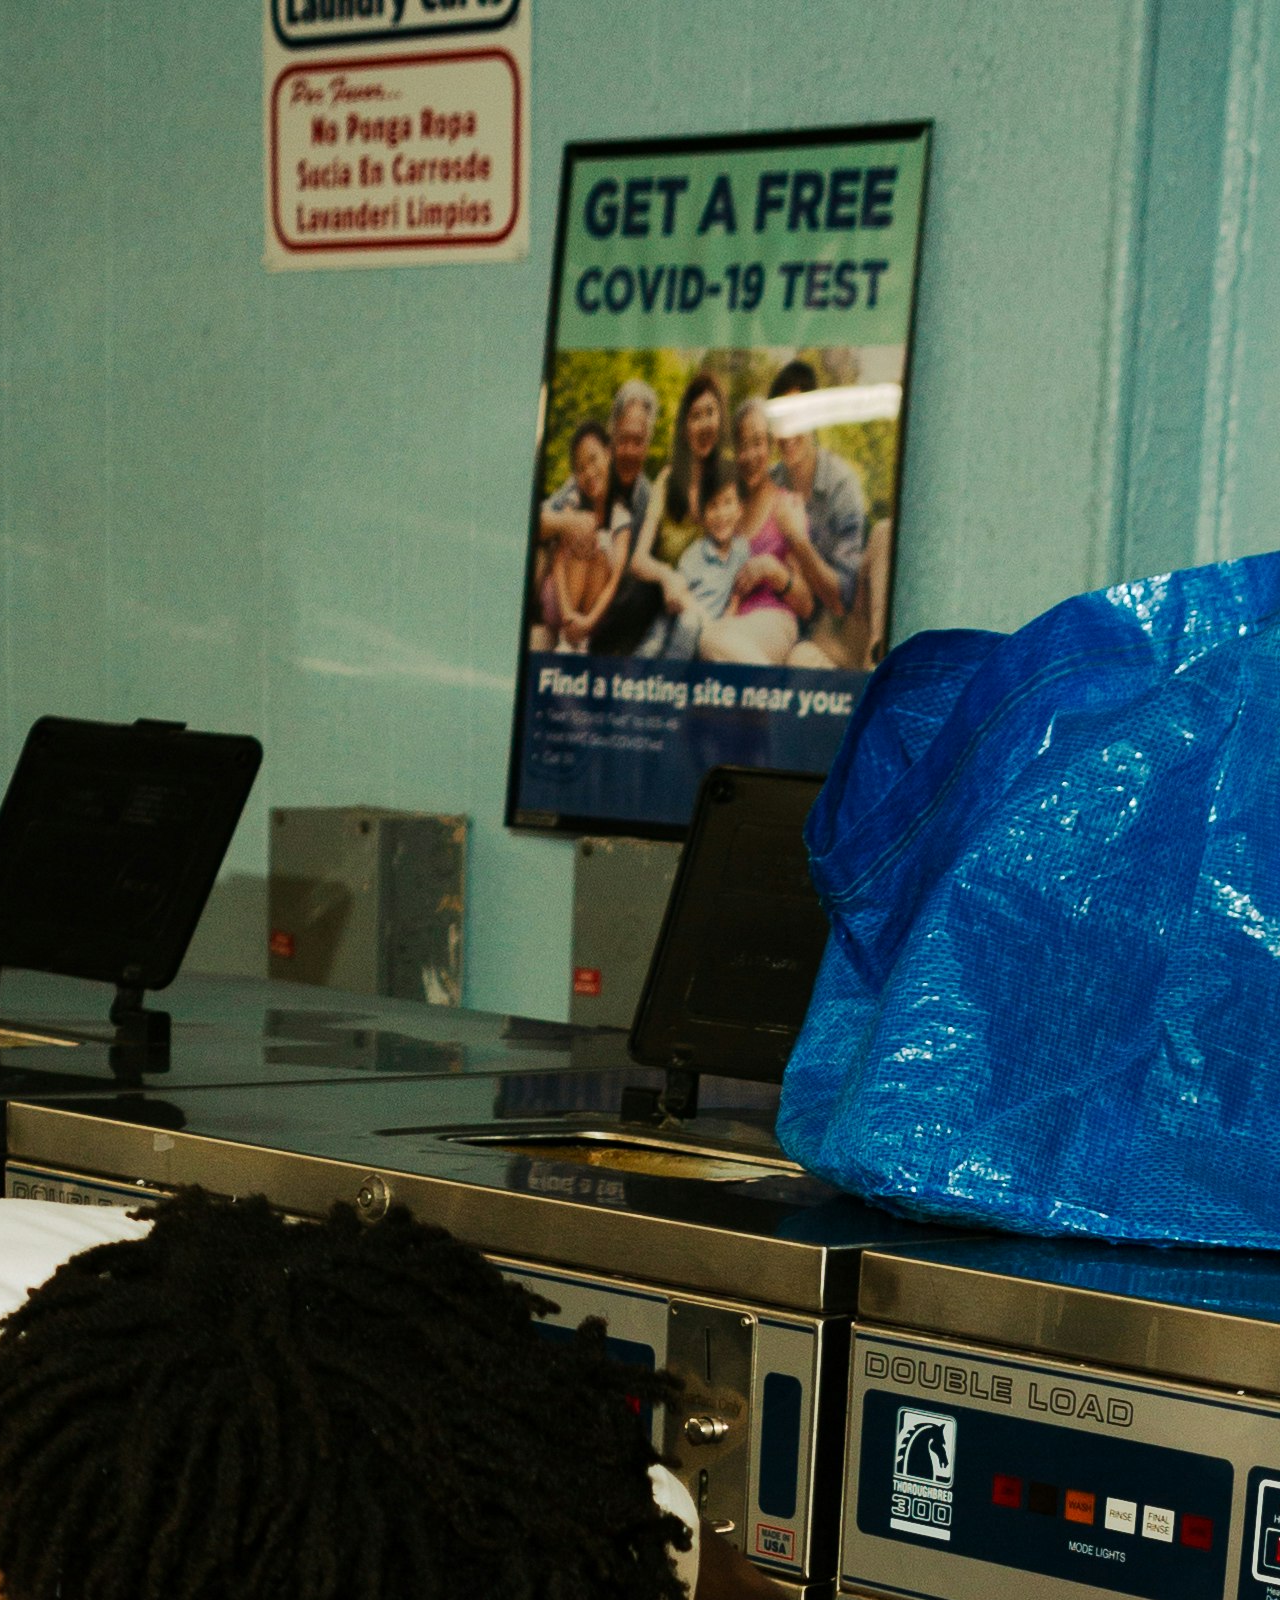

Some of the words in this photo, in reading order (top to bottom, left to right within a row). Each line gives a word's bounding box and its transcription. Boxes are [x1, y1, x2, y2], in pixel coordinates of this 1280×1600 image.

[311, 114, 338, 146] No
[346, 111, 412, 149] Ponga
[420, 106, 477, 145] Ropa
[296, 157, 351, 191] Sucia
[359, 153, 384, 188] En
[296, 198, 400, 234] Lavanderi
[406, 193, 491, 235] Limpios
[583, 174, 689, 241] GET
[699, 172, 738, 237] A
[755, 165, 899, 234] FREE
[576, 261, 767, 317] COVID-19
[779, 258, 890, 312] TEST
[538, 668, 588, 697] Find
[593, 677, 607, 699] a
[612, 673, 688, 709] testing
[692, 678, 736, 708] site
[742, 686, 792, 711] near
[797, 691, 854, 718] you:
[865, 1350, 1014, 1405] DOUBLE
[1028, 1381, 1134, 1428] LOAD
[892, 1479, 953, 1503] THOROUGHBRED
[1068, 1500, 1092, 1513] WASH
[891, 1493, 952, 1526] 300
[1109, 1509, 1133, 1523] RINSE
[1148, 1511, 1170, 1524] FINAL
[1146, 1521, 1170, 1535] RINSE
[764, 1539, 786, 1555] USA
[1068, 1540, 1093, 1556] MODE
[1095, 1546, 1126, 1563] LIGHTS
